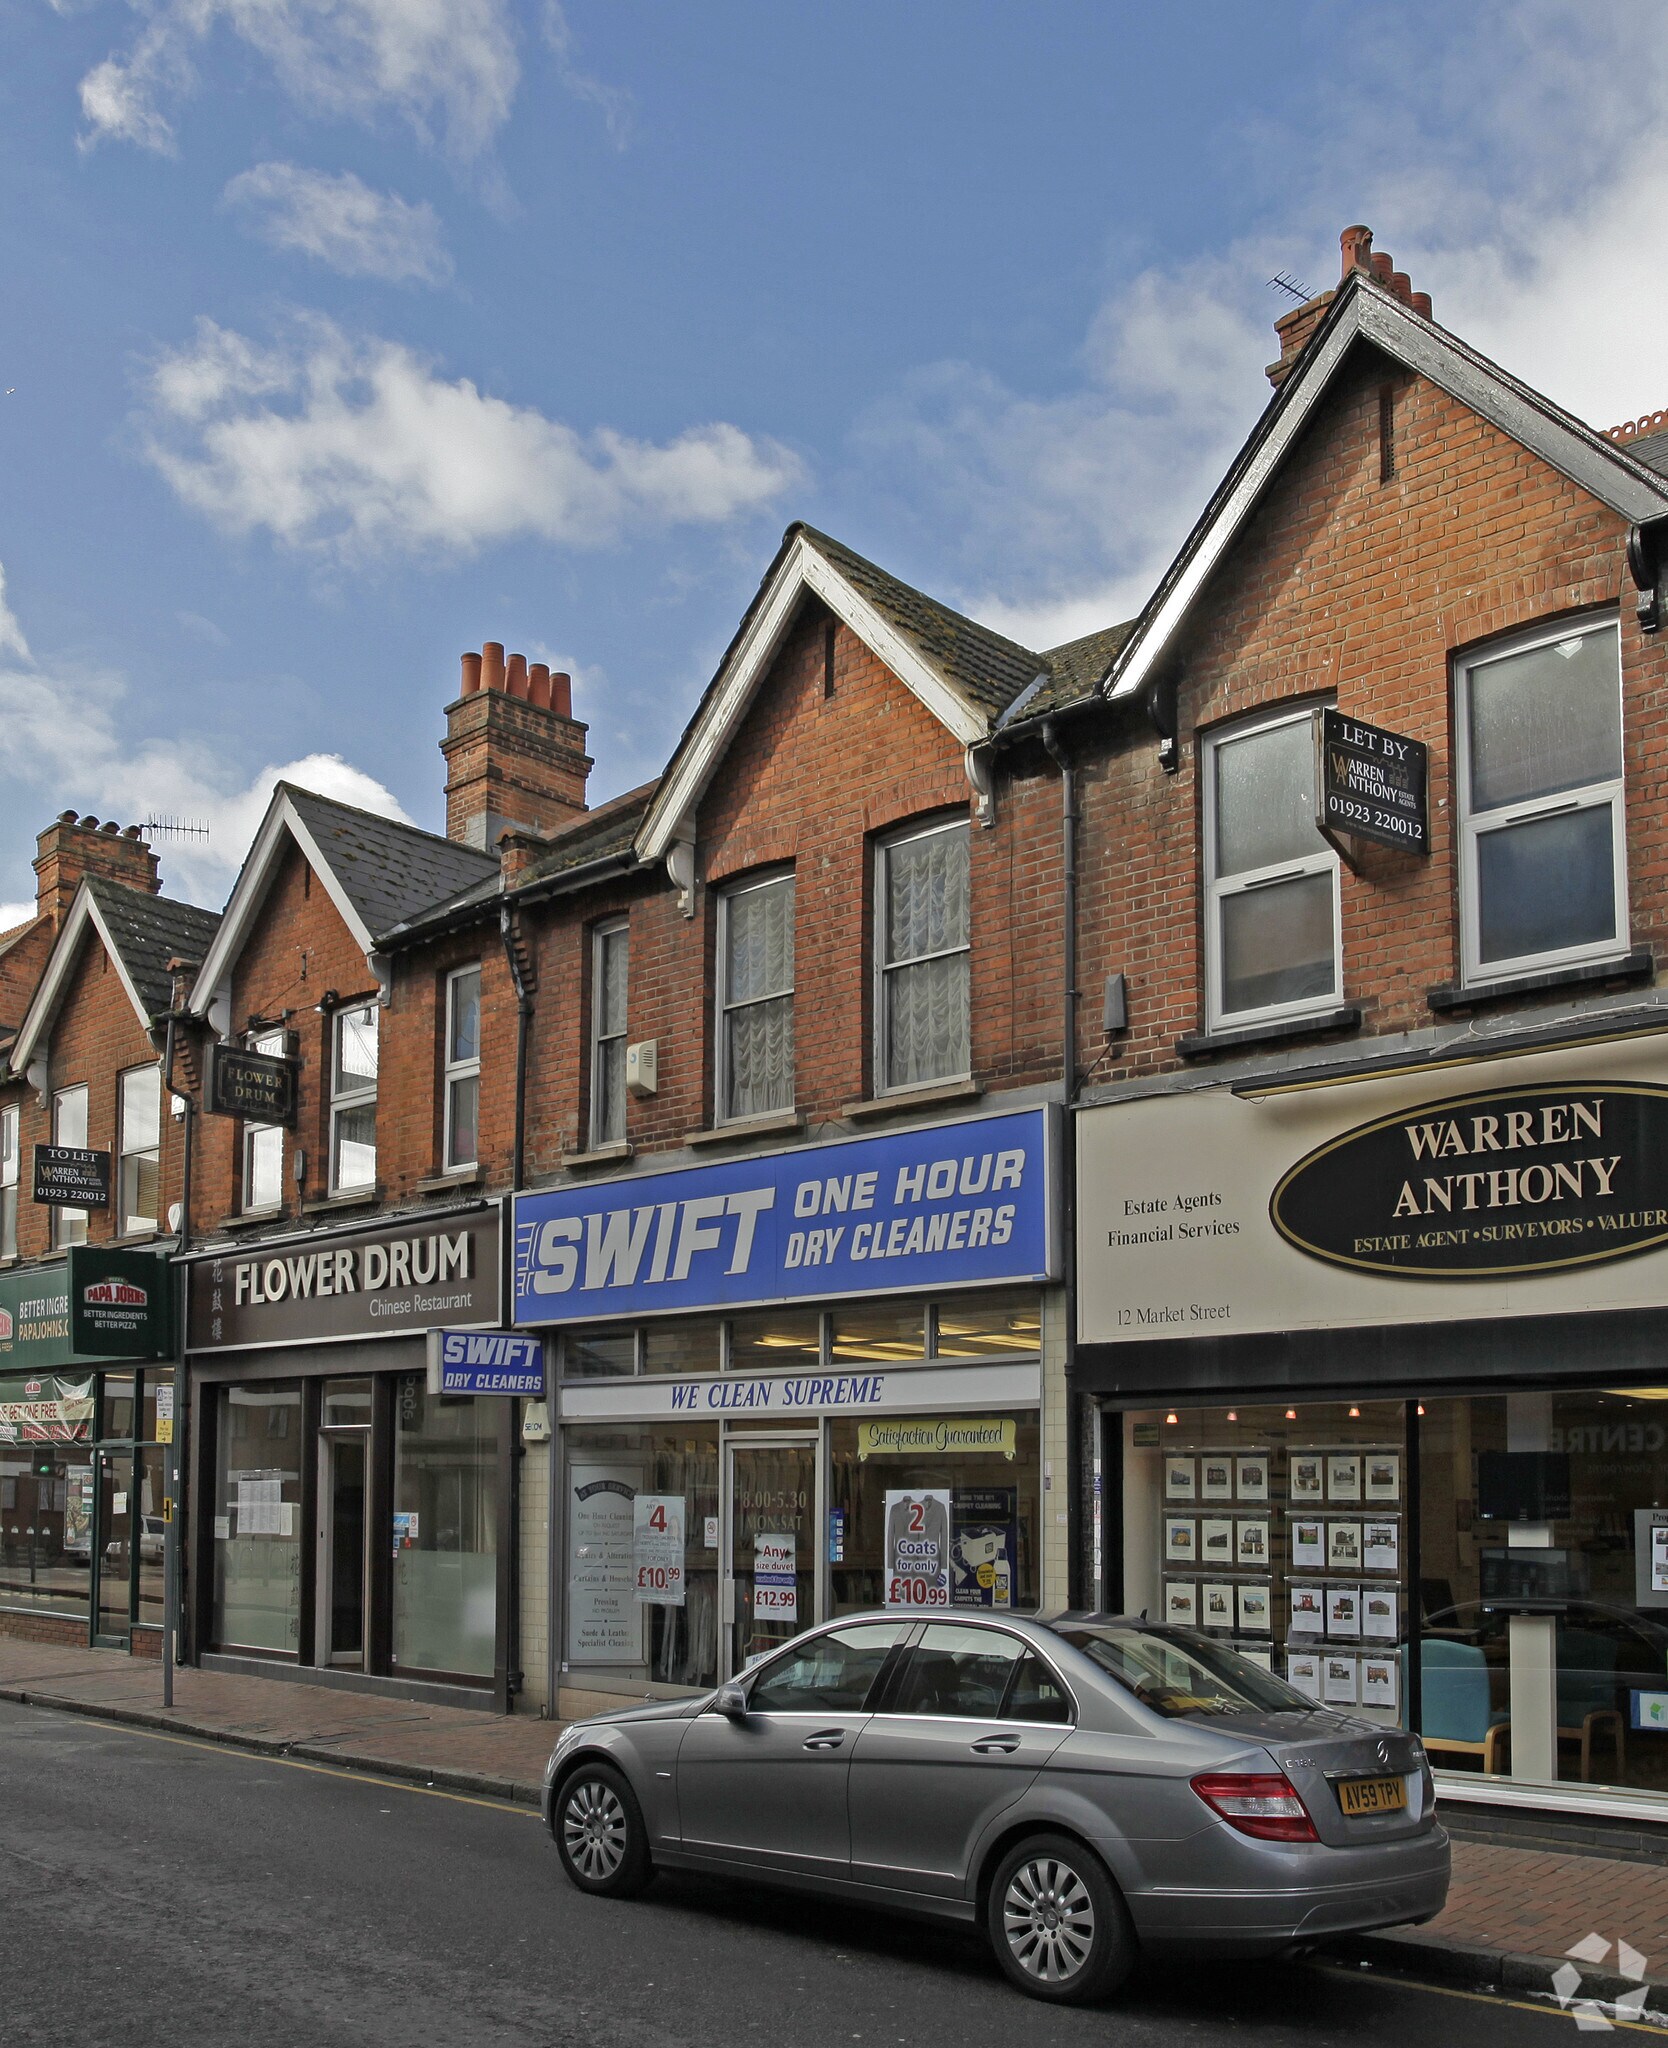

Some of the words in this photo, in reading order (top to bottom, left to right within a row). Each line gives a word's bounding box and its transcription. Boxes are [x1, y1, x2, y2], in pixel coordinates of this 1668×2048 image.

[1342, 723, 1377, 750] LET
[1382, 737, 1408, 761] BY
[1331, 752, 1385, 784] WARREN
[1336, 766, 1398, 803] ANTHONY
[1329, 796, 1370, 823] 01923
[1374, 811, 1422, 839] 220012
[228, 1067, 283, 1089] FLOWER
[235, 1086, 276, 1104] DRUM
[1404, 1099, 1605, 1162] WARREN
[47, 1148, 69, 1160] TO
[72, 1151, 98, 1162] LET
[41, 1165, 79, 1177] WARREN
[43, 1172, 89, 1186] ANTHONY
[37, 1187, 68, 1198] 01923
[70, 1190, 106, 1201] 220012
[793, 1170, 879, 1219] ONE
[893, 1148, 1026, 1206] HOUR
[1392, 1156, 1622, 1218] ANTHONY
[1123, 1198, 1168, 1216] Estate
[1172, 1191, 1222, 1213] Agents
[533, 1186, 776, 1296] SWIFT
[783, 1226, 846, 1269] DRY
[849, 1204, 1016, 1262] CLEANERS
[1107, 1224, 1174, 1247] Financial
[1178, 1219, 1241, 1240] Services
[1353, 1233, 1411, 1254] ESTATE
[1416, 1228, 1470, 1249] AGENT
[1481, 1217, 1584, 1242] SURVEYORS
[1597, 1209, 1668, 1231] VALUER
[235, 1248, 355, 1306] FLOWER
[363, 1230, 470, 1291] DRUM
[88, 1284, 113, 1302] PAPA
[369, 1298, 412, 1317] Chinese
[413, 1291, 473, 1313] Restaurant
[20, 1299, 46, 1319] BETTER
[84, 1310, 107, 1318] BETTER
[107, 1311, 148, 1321] INGREDIENTS
[1117, 1309, 1132, 1326] 12
[1137, 1306, 1185, 1324] Market
[1189, 1303, 1231, 1320] Street
[94, 1320, 118, 1329] BETTER
[118, 1321, 138, 1330] PIZZA
[444, 1335, 541, 1367] SWIFT
[445, 1372, 472, 1388] DRY
[475, 1374, 543, 1390] CLEANERS
[671, 1384, 700, 1409] WE
[707, 1381, 773, 1408] CLEAN
[782, 1376, 885, 1407] SUPREME
[25, 1403, 39, 1419] ONE
[41, 1402, 57, 1418] FREE
[868, 1423, 935, 1452] Satisfaction
[935, 1421, 1005, 1451] Guaranteed
[742, 1490, 808, 1509] 8.00-5.30
[649, 1504, 668, 1533] 4
[747, 1515, 803, 1531] MON-SAT
[909, 1503, 924, 1532] 2
[763, 1545, 786, 1561] Any
[898, 1540, 937, 1555] Coats
[637, 1566, 680, 1590] £10.99
[756, 1562, 770, 1570] size
[771, 1562, 794, 1571] duvet
[897, 1559, 912, 1571] for
[914, 1559, 937, 1574] only
[755, 1590, 796, 1607] £12.99
[888, 1578, 948, 1606] £10.99
[577, 1638, 606, 1649] Specialist
[581, 1628, 596, 1637] Suede
[600, 1628, 606, 1637] &
[1345, 1783, 1379, 1810] AV59
[1378, 1781, 1401, 1806] TPY
